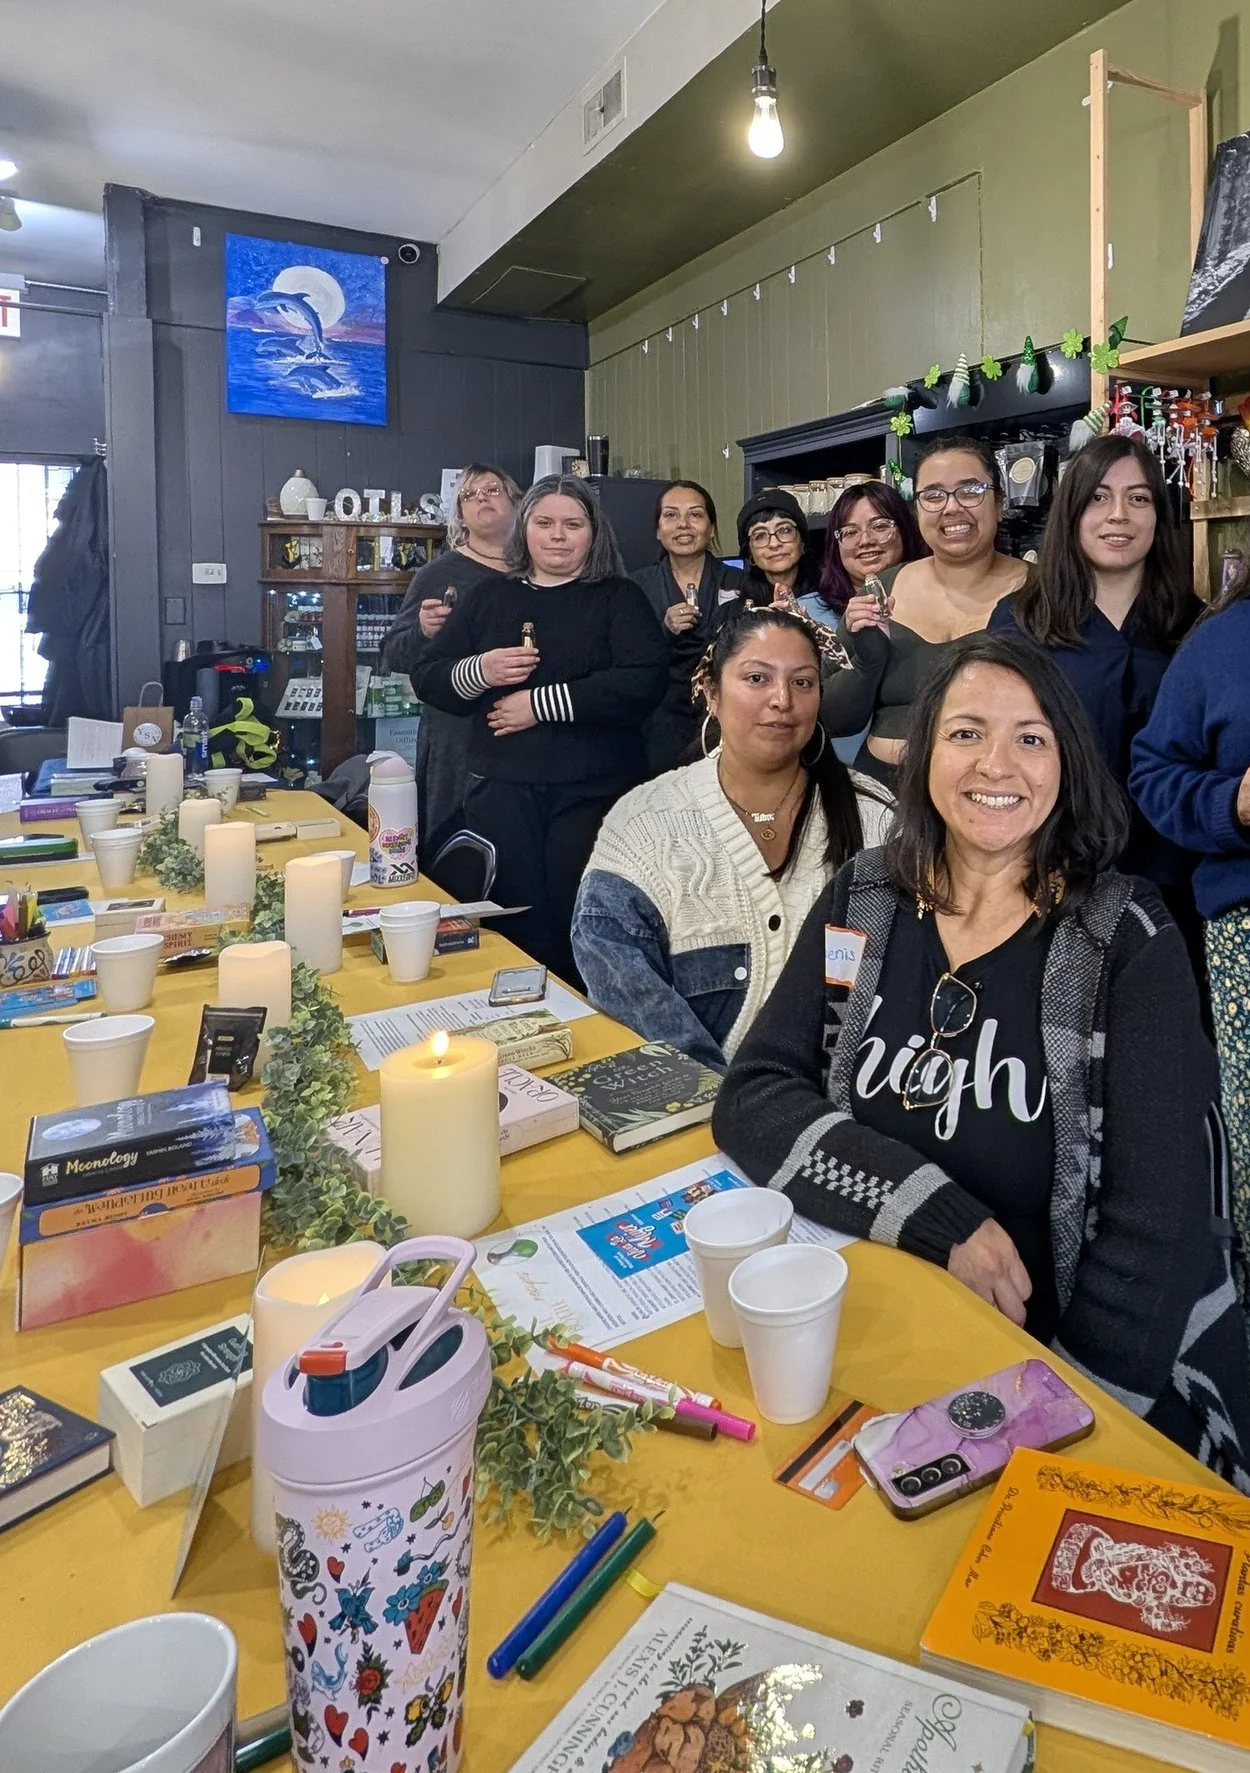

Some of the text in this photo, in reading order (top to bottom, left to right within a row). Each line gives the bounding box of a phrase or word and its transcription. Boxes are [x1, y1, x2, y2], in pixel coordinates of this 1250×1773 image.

[334, 487, 445, 525] OILS
[827, 947, 856, 962] enis
[499, 1068, 560, 1103] ORACLE
[593, 1060, 663, 1085] Green
[600, 1066, 674, 1091] Witch
[65, 1150, 139, 1175] Moonology
[656, 1616, 694, 1662] reconnecting
[1225, 1600, 1246, 1655] curativas
[625, 1627, 670, 1681] ALEXIS
[649, 1658, 660, 1672] to
[638, 1670, 651, 1687] the
[583, 1727, 609, 1754] bodies
[879, 1700, 914, 1755] SEASONAL
[902, 1694, 963, 1773] Apoth
[573, 1755, 586, 1768] &
